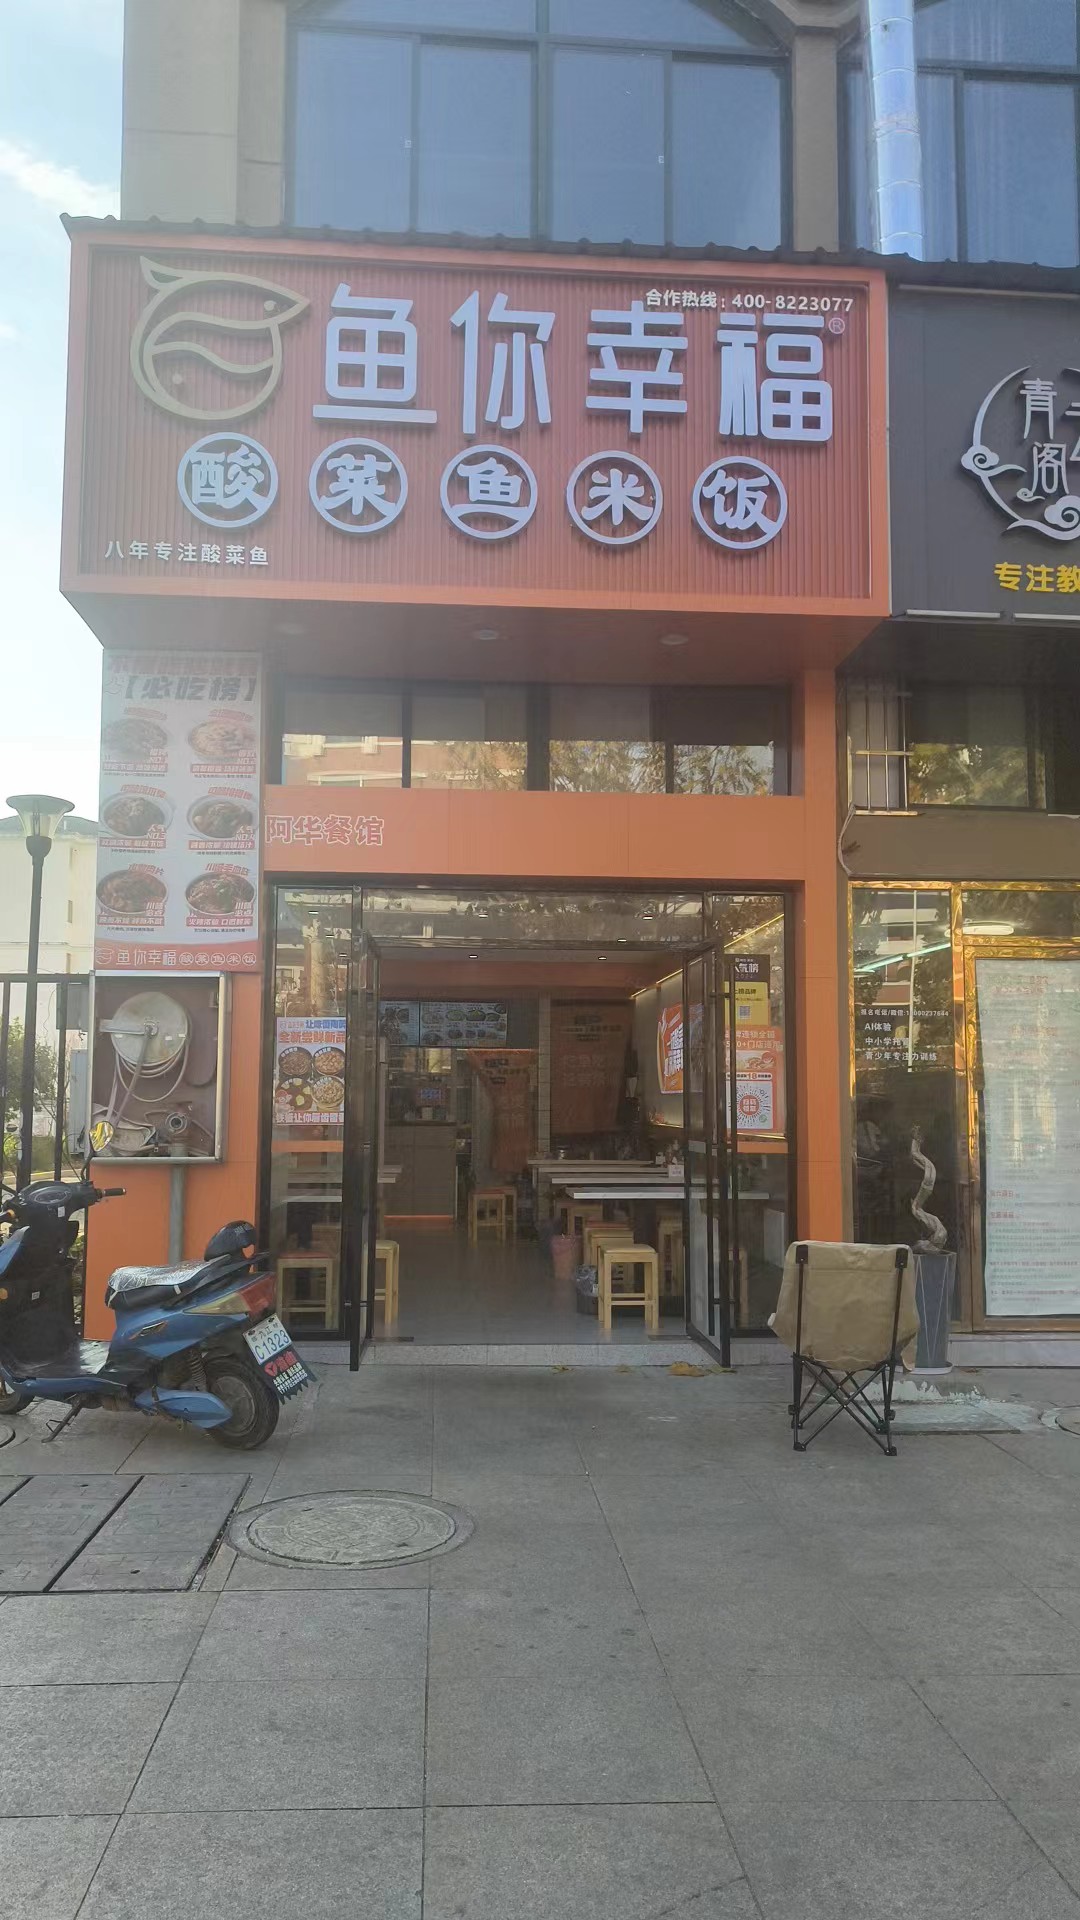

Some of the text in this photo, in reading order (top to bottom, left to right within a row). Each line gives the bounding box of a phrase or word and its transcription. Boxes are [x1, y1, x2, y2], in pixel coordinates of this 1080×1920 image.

[313, 283, 833, 441] 鱼你幸福
[181, 437, 783, 546] 酸菜鱼米饭
[104, 540, 269, 567] 八年专注酸菜鱼
[265, 814, 384, 845] 阿华餐馆
[864, 1022, 891, 1031] AI体验
[254, 1329, 291, 1361] C1323
